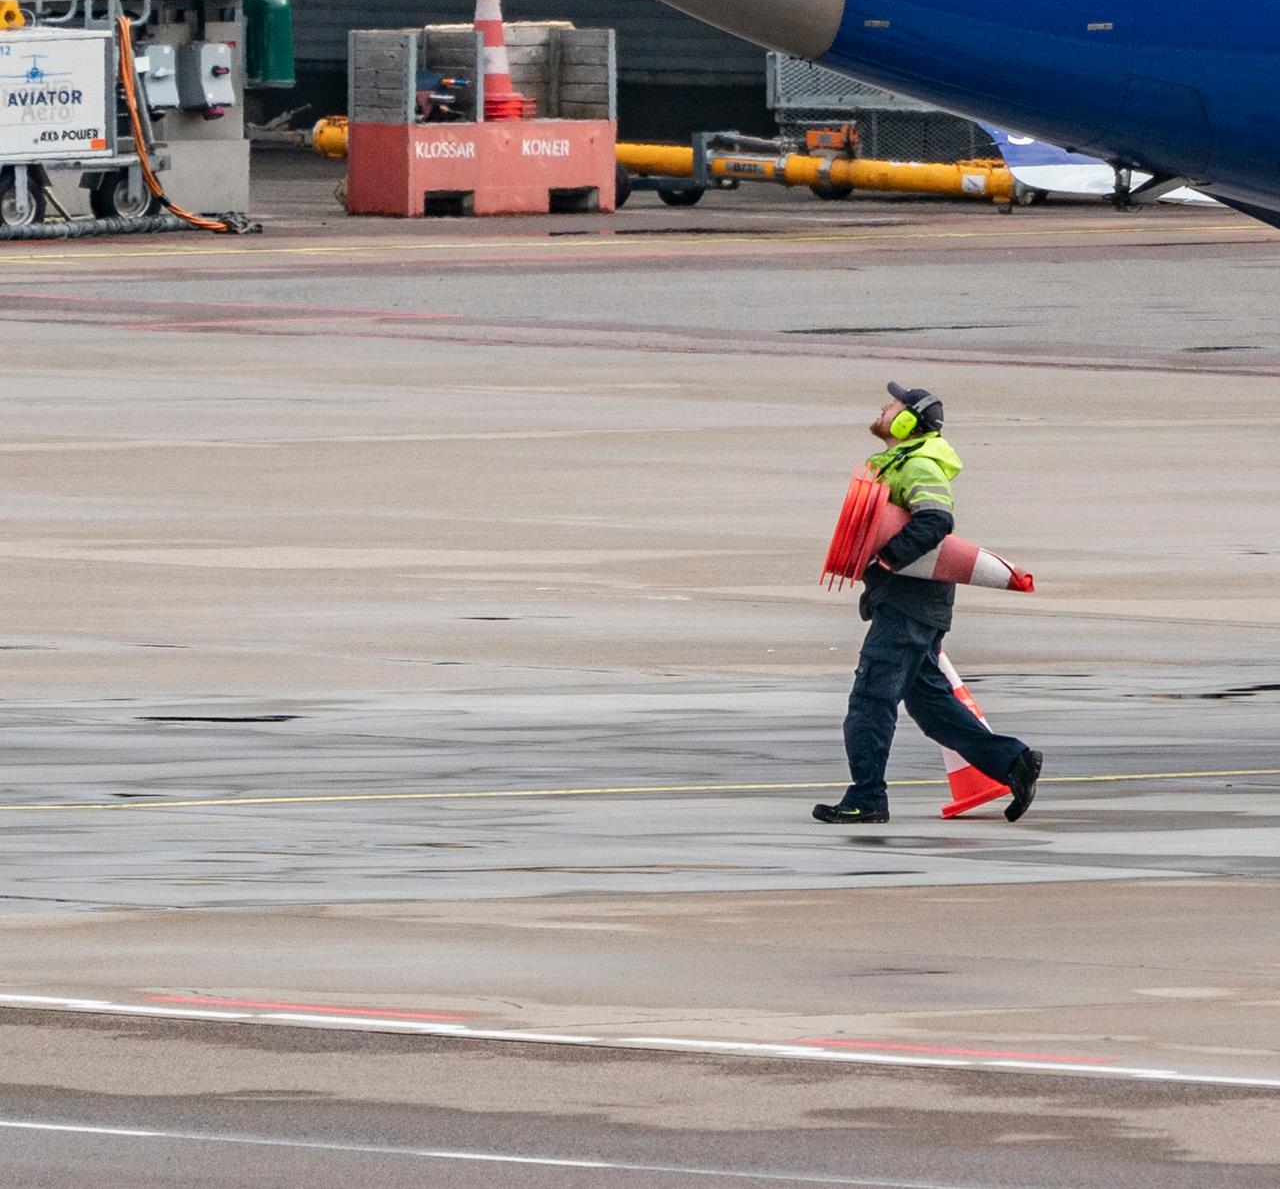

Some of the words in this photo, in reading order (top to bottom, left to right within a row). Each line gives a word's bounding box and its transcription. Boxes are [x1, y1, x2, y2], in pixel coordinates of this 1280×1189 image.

[8, 90, 82, 107] AVIATOR
[62, 129, 99, 141] POWER
[415, 141, 476, 158] KLOSSAR
[522, 139, 570, 156] KONER
